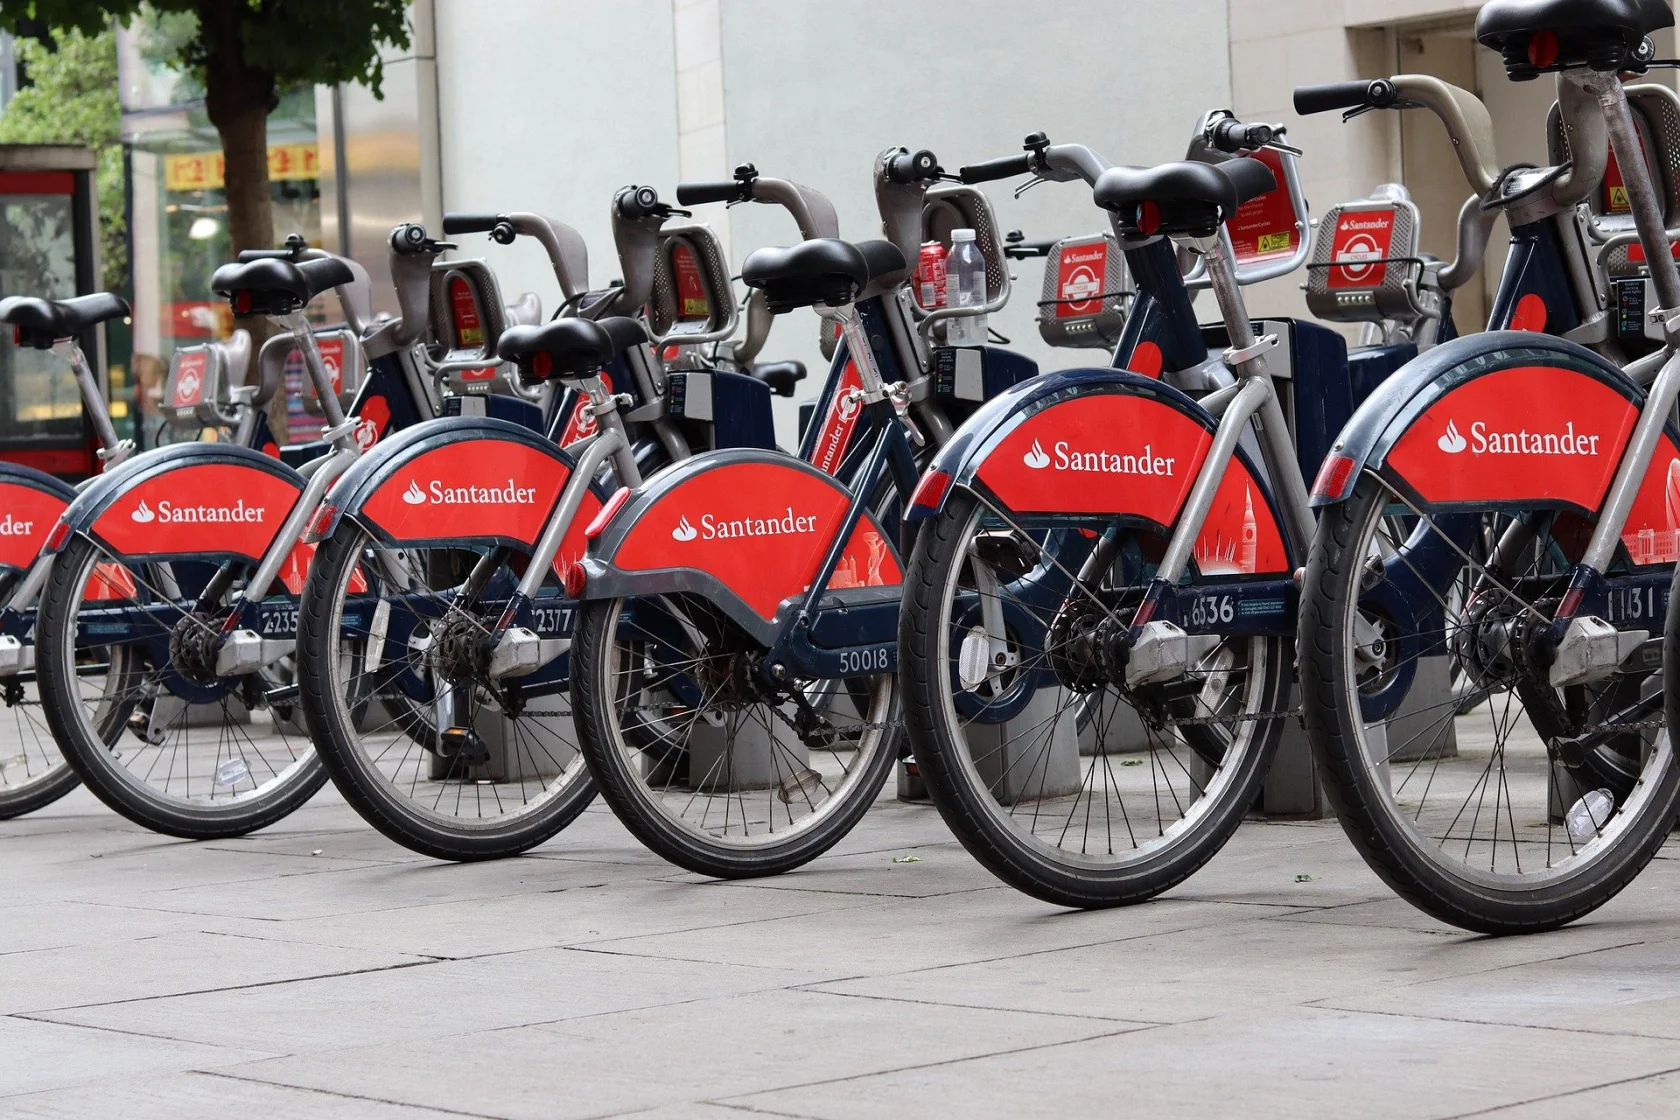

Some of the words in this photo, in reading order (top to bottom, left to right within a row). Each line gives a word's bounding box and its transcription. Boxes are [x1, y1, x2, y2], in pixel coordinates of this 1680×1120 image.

[1349, 218, 1389, 230] Santander
[1072, 250, 1103, 263] Santander
[822, 423, 844, 473] ntander
[1471, 421, 1599, 455] Santander
[1054, 441, 1175, 476] Santander
[429, 478, 536, 504] Santander
[158, 499, 264, 523] Santander
[701, 506, 817, 540] Santander
[0, 513, 33, 535] der
[840, 648, 888, 673] 50018
